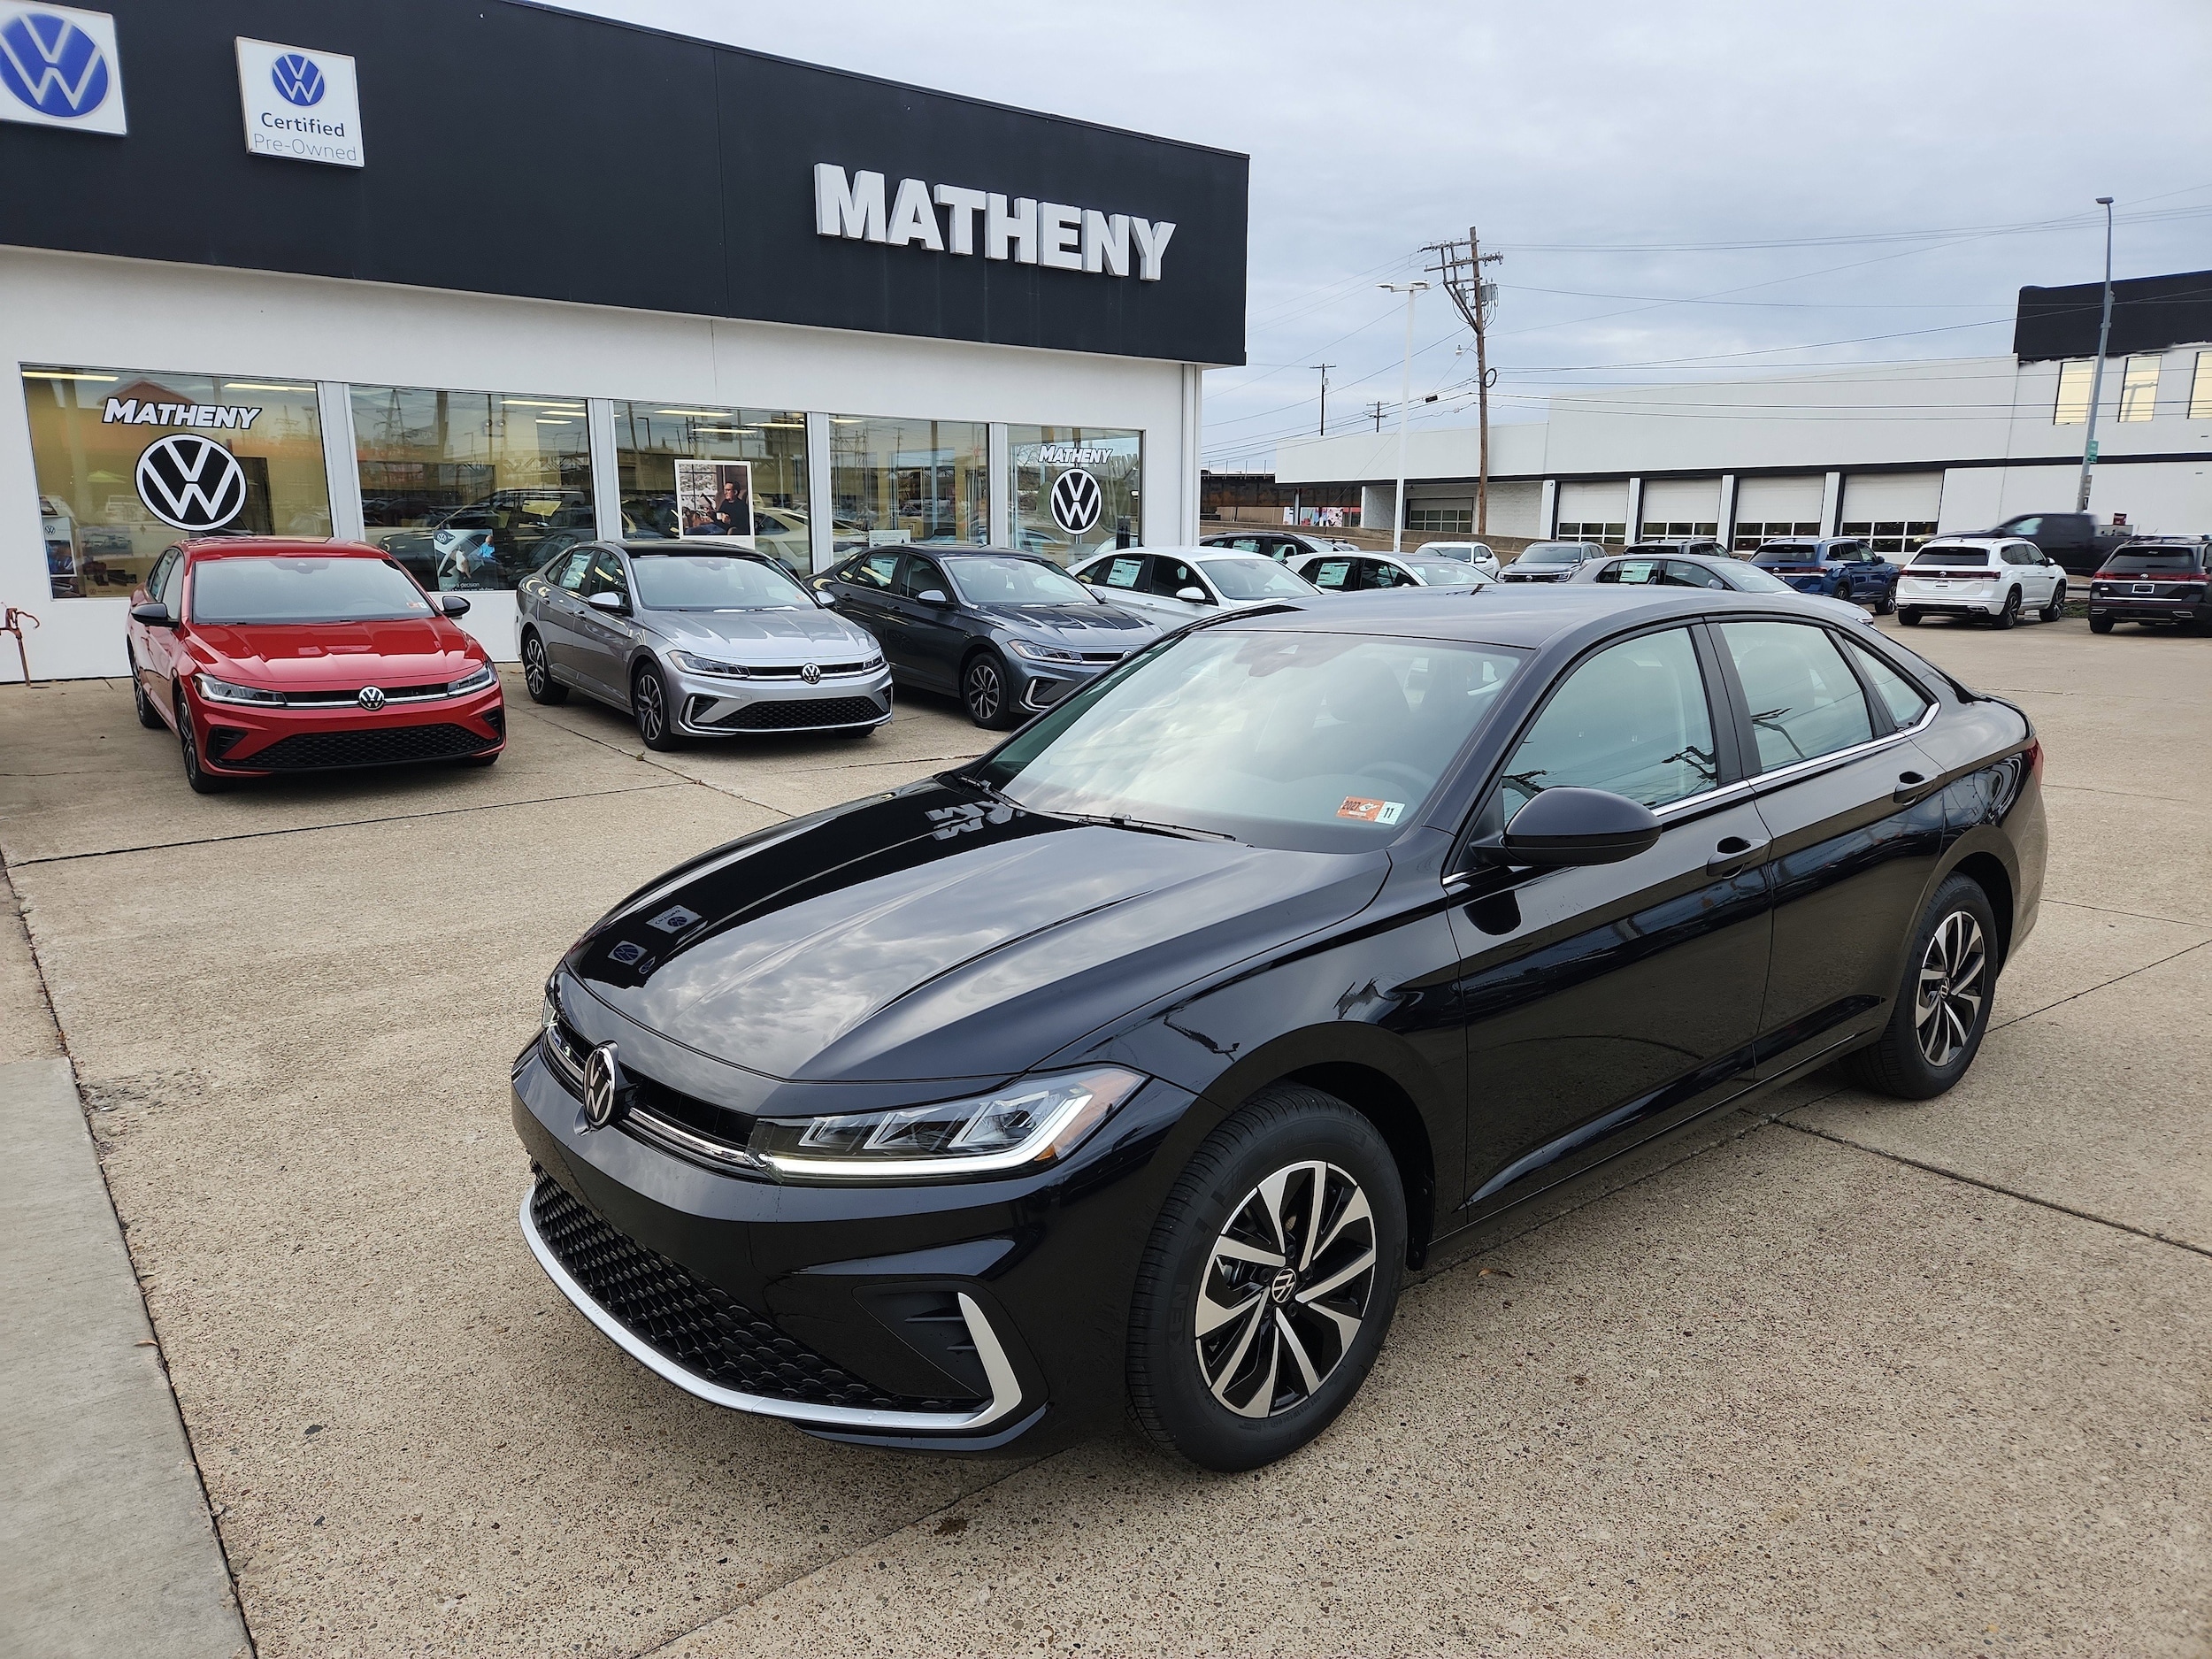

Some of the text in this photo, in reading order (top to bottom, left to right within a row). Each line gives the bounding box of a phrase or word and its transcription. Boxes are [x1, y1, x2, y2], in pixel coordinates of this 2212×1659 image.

[271, 53, 324, 104] VW
[260, 111, 346, 138] Certified
[253, 133, 357, 162] Pre-Owned
[813, 162, 1177, 281] MATHENY
[102, 397, 262, 429] MATHENY
[1038, 445, 1113, 464] MATHENY
[140, 439, 241, 523] VW
[1053, 471, 1099, 528] VW
[1341, 800, 1362, 811] 2027
[1383, 807, 1395, 818] 11
